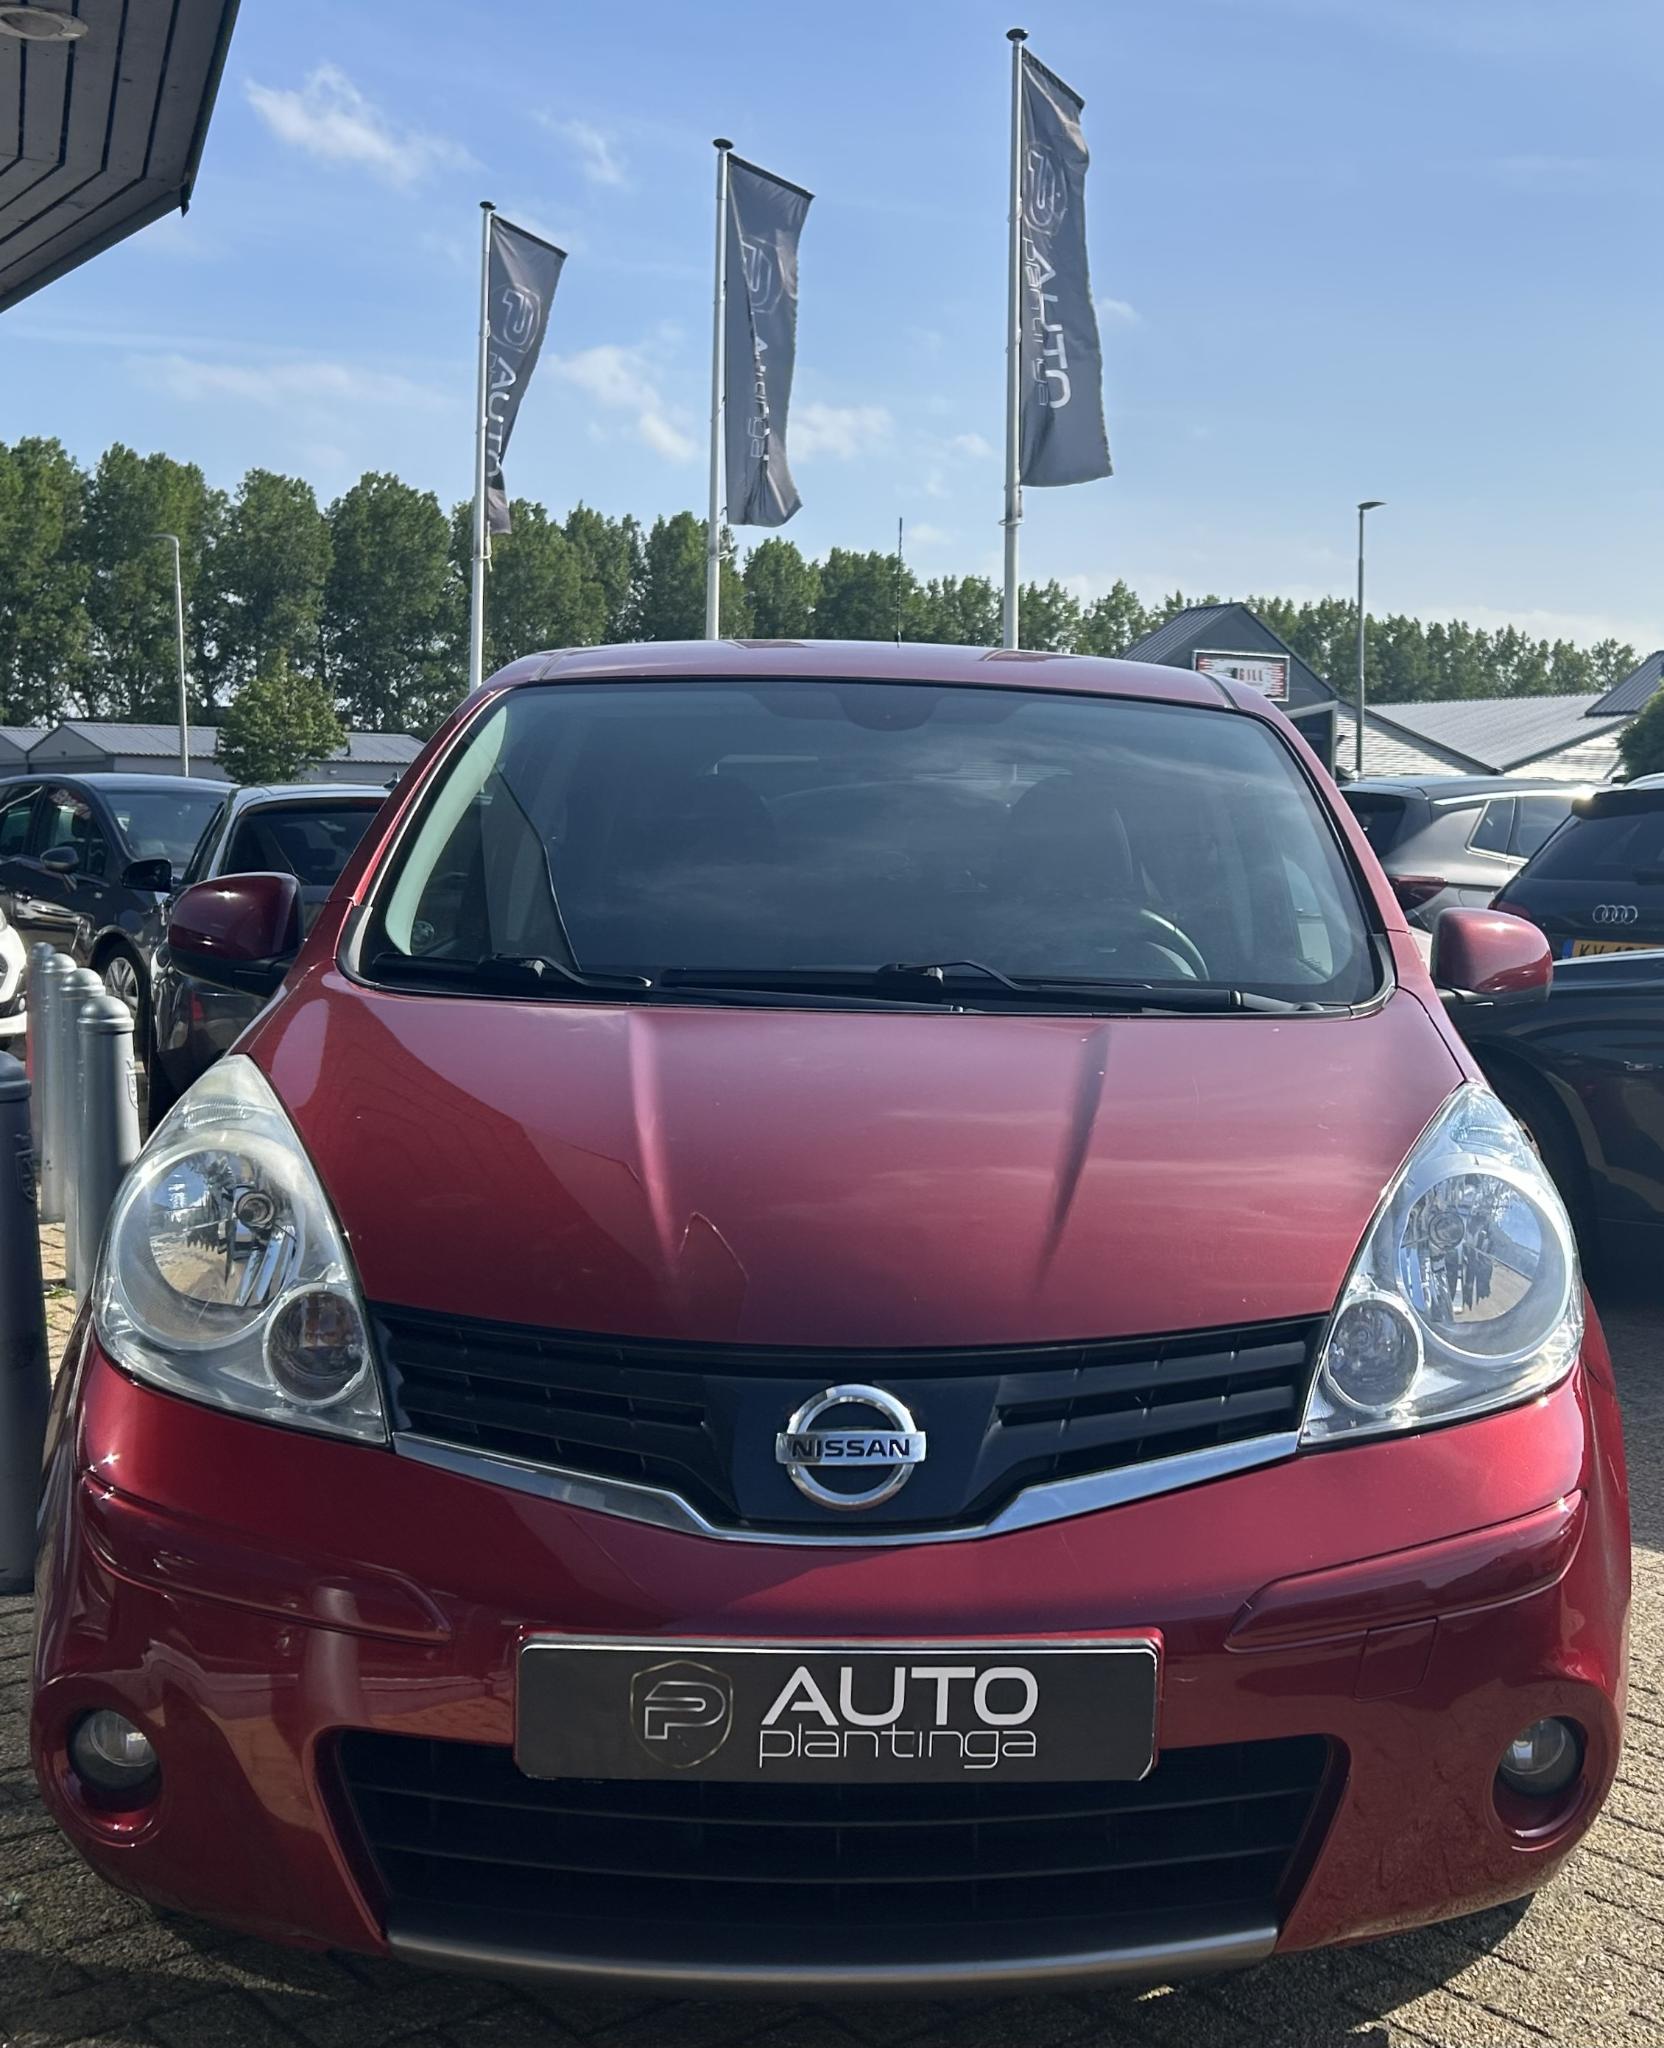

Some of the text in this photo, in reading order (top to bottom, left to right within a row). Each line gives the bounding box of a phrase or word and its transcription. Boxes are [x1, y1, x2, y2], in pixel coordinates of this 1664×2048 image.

[792, 1439, 910, 1457] NISSAN
[760, 1665, 1039, 1727] AUTO
[759, 1722, 1037, 1770] plantinga
